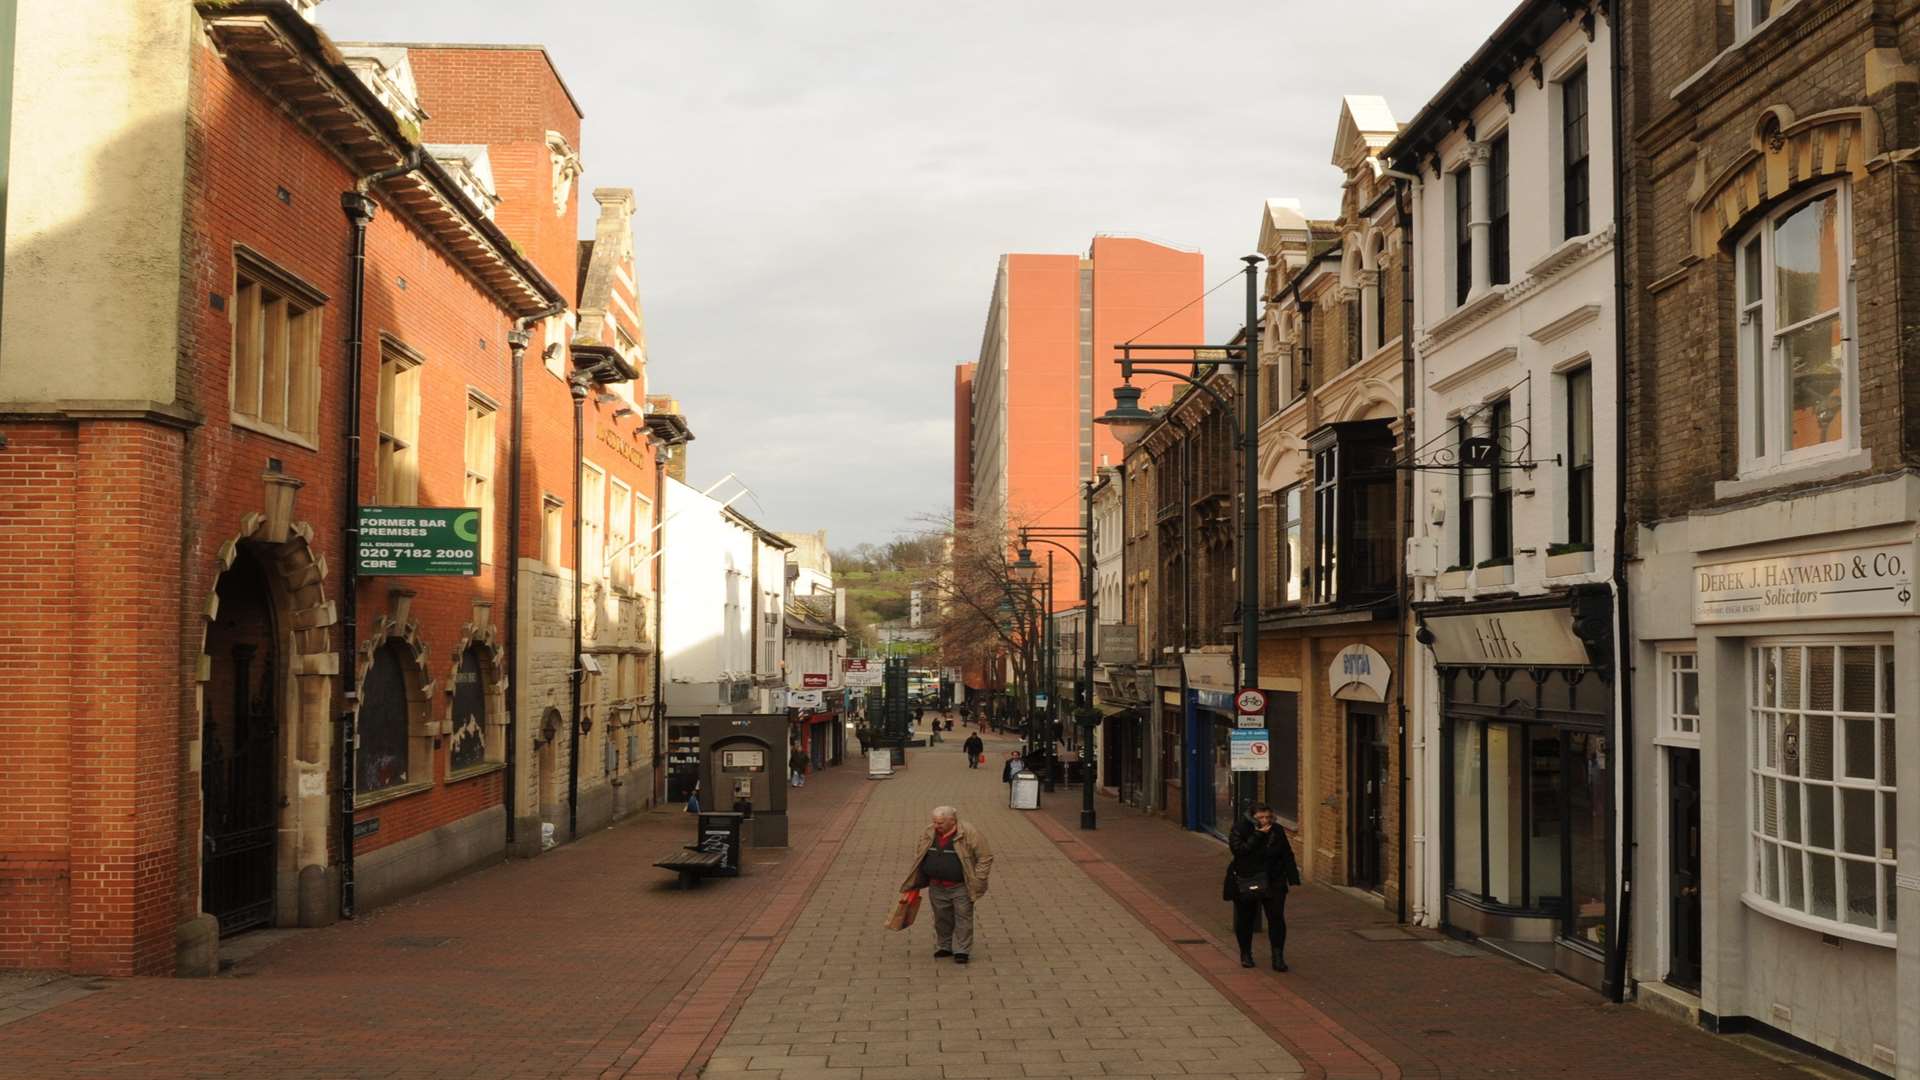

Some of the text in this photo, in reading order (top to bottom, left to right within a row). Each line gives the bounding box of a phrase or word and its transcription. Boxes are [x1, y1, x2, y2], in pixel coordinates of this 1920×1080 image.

[1471, 445, 1492, 459] 17
[359, 518, 447, 527] FORMER BAR
[359, 528, 428, 536] PREMISES
[359, 548, 474, 558] 020 7182 2000
[360, 560, 397, 568] CBRE
[1700, 571, 1744, 593] DEREK
[1749, 567, 1761, 589] J.
[1765, 562, 1846, 587] HAYWARD
[1851, 555, 1868, 579] &
[1763, 588, 1818, 606] Solicitors
